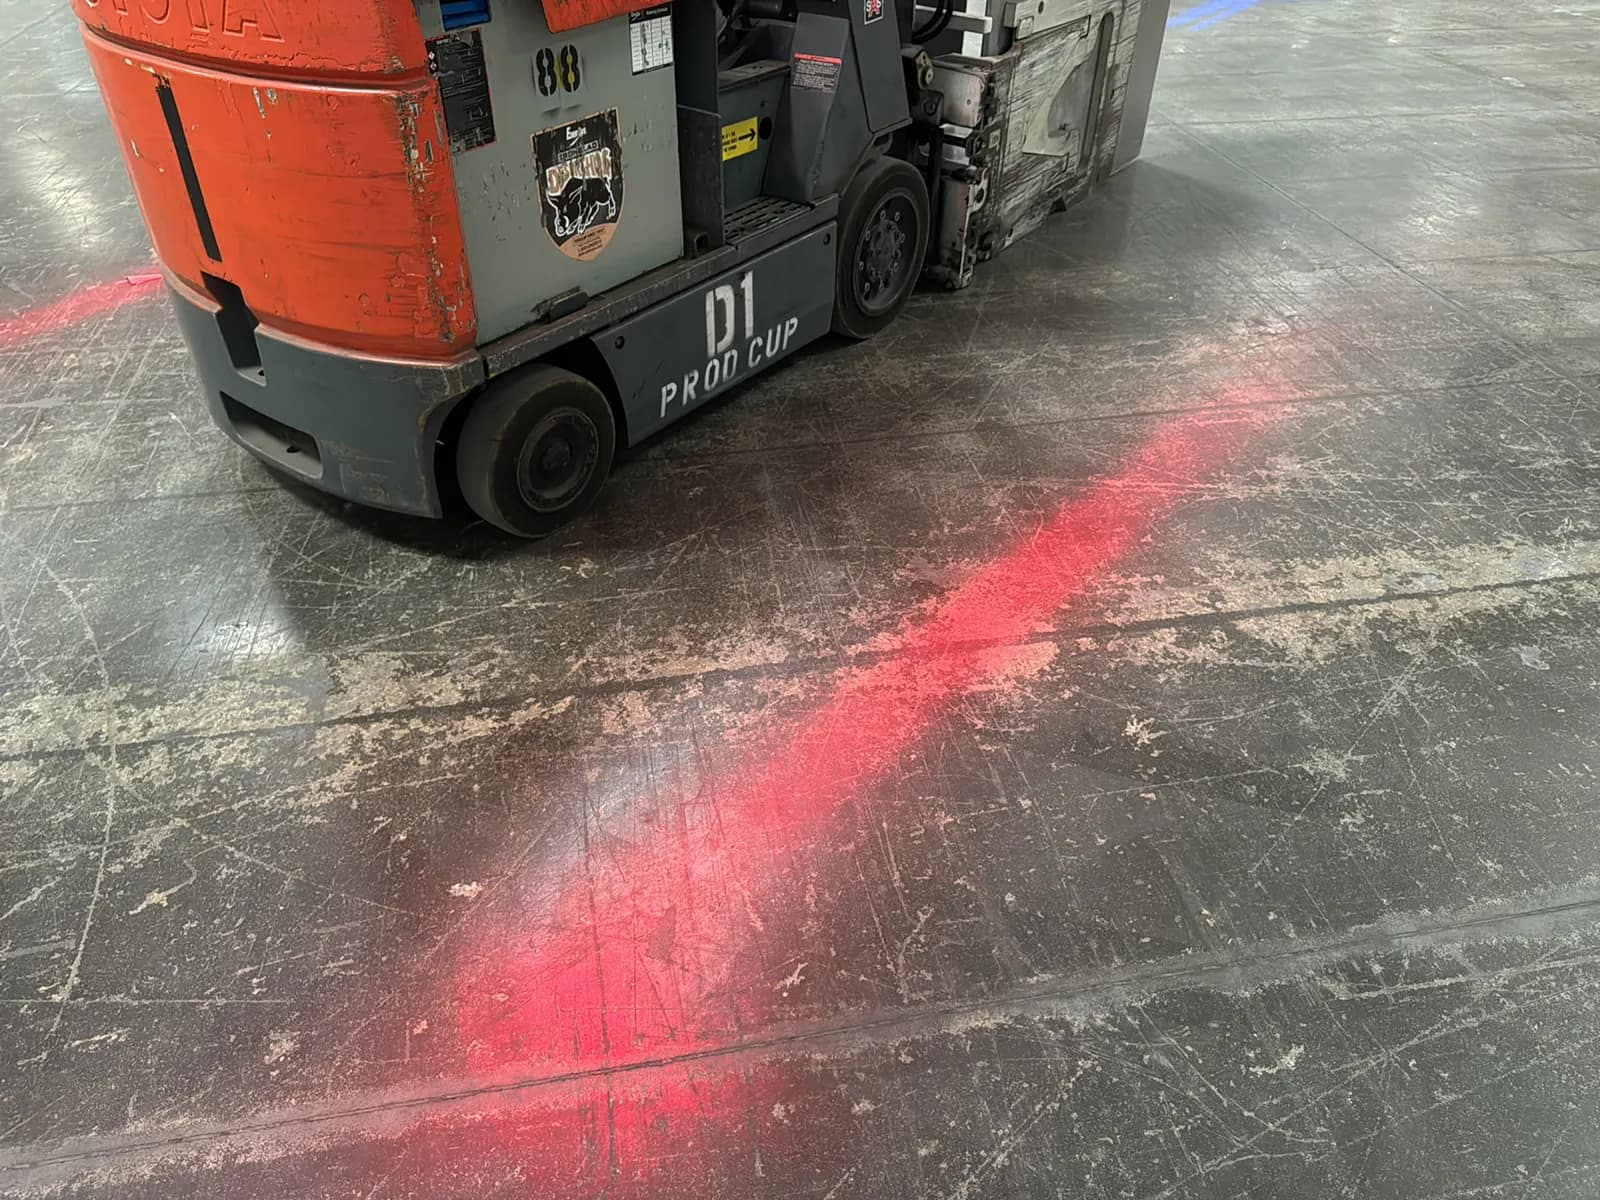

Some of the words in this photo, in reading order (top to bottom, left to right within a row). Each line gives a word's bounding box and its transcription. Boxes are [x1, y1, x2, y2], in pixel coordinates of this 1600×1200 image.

[536, 44, 581, 96] 88
[705, 270, 754, 358] D1
[660, 349, 738, 418] PROD
[748, 317, 799, 368] CUP
